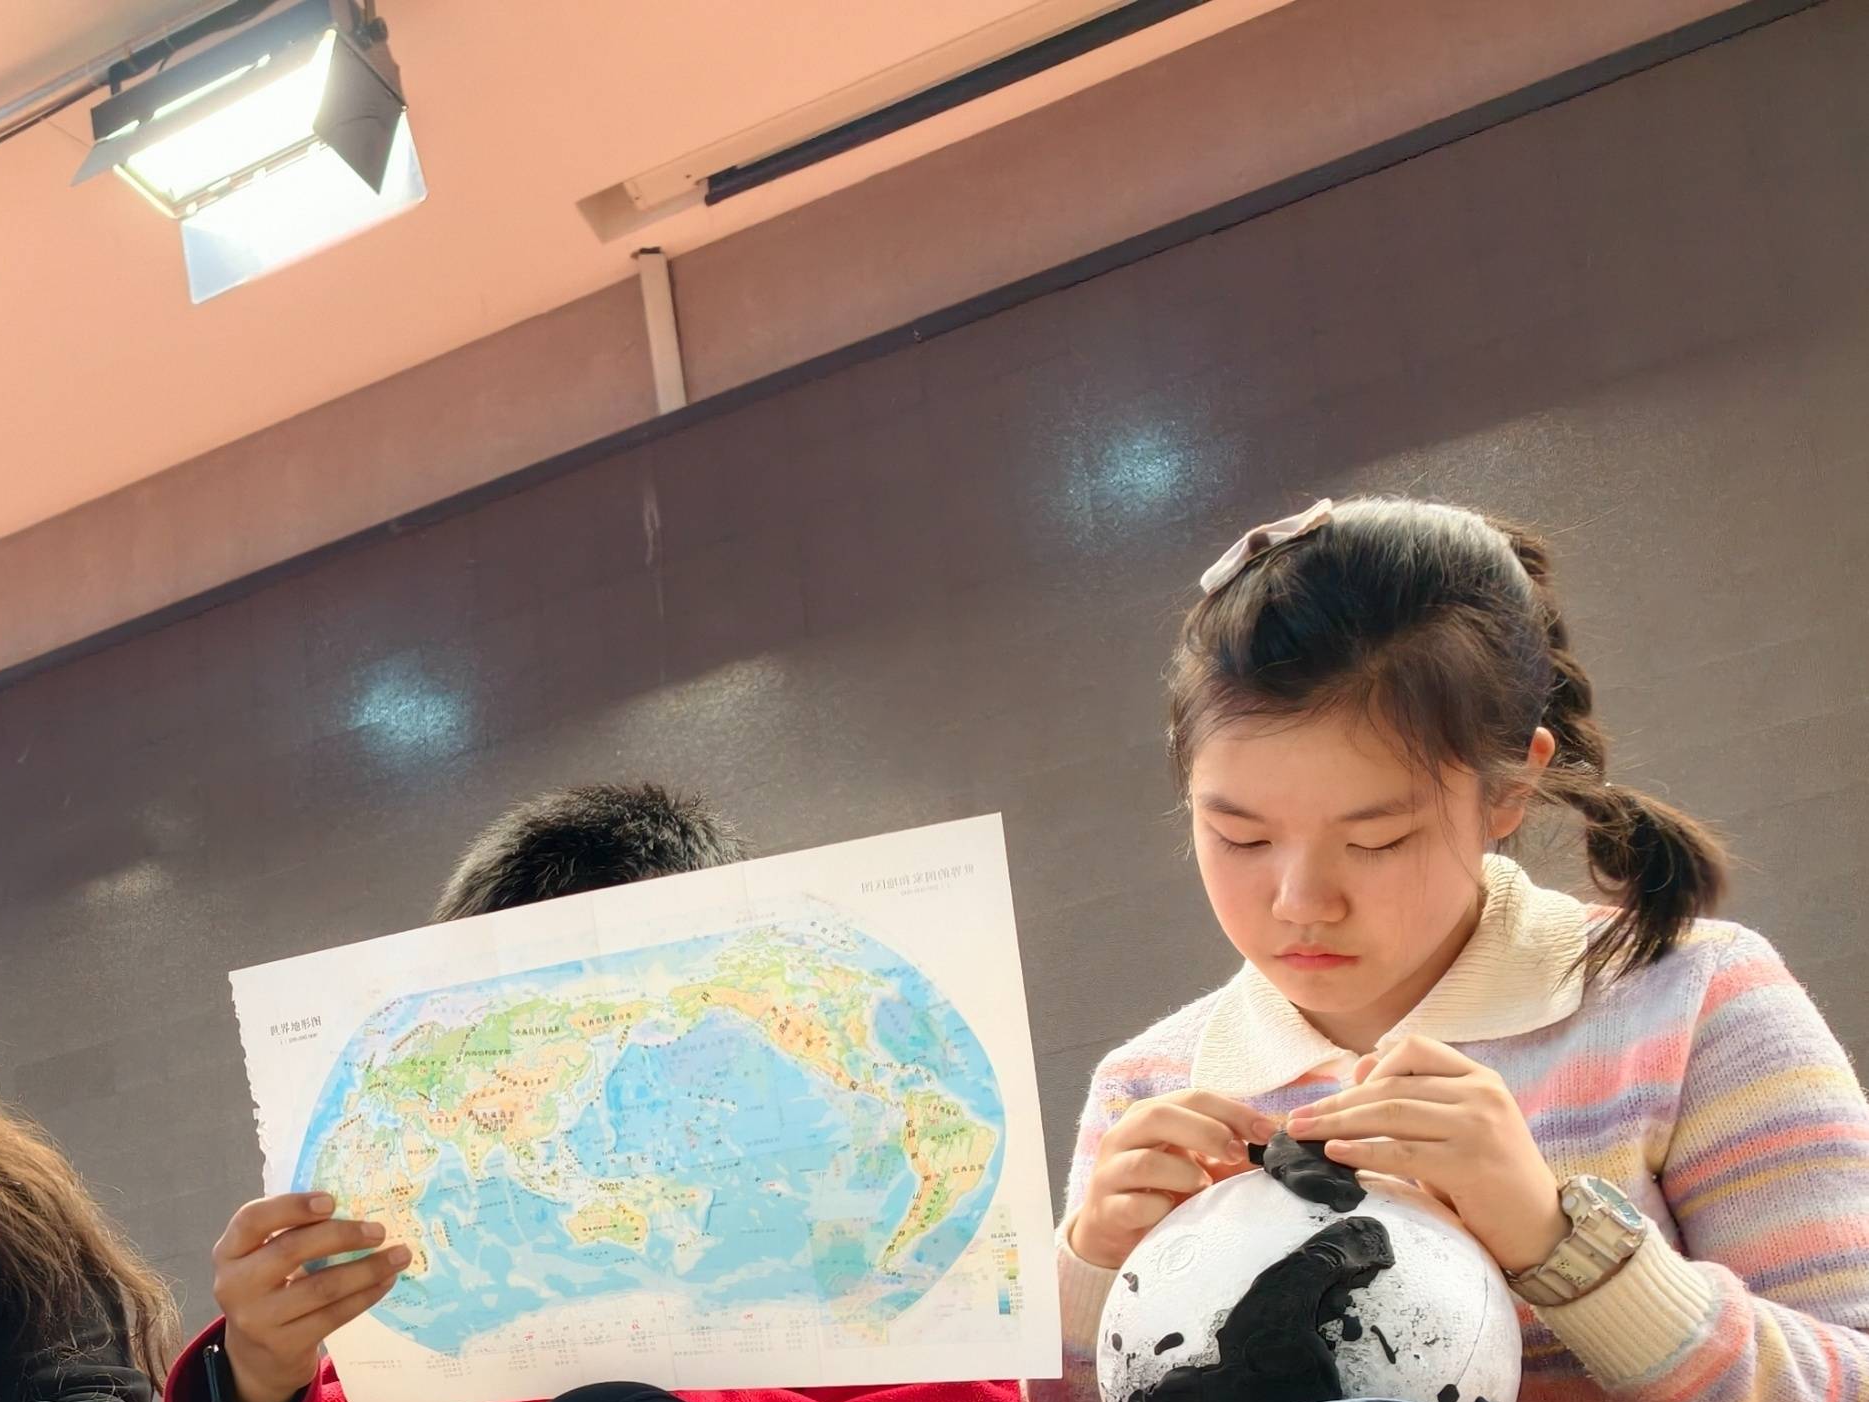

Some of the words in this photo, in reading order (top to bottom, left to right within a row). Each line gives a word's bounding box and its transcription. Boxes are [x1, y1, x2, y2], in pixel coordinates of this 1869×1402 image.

[269, 1015, 322, 1037] 世界地形图
